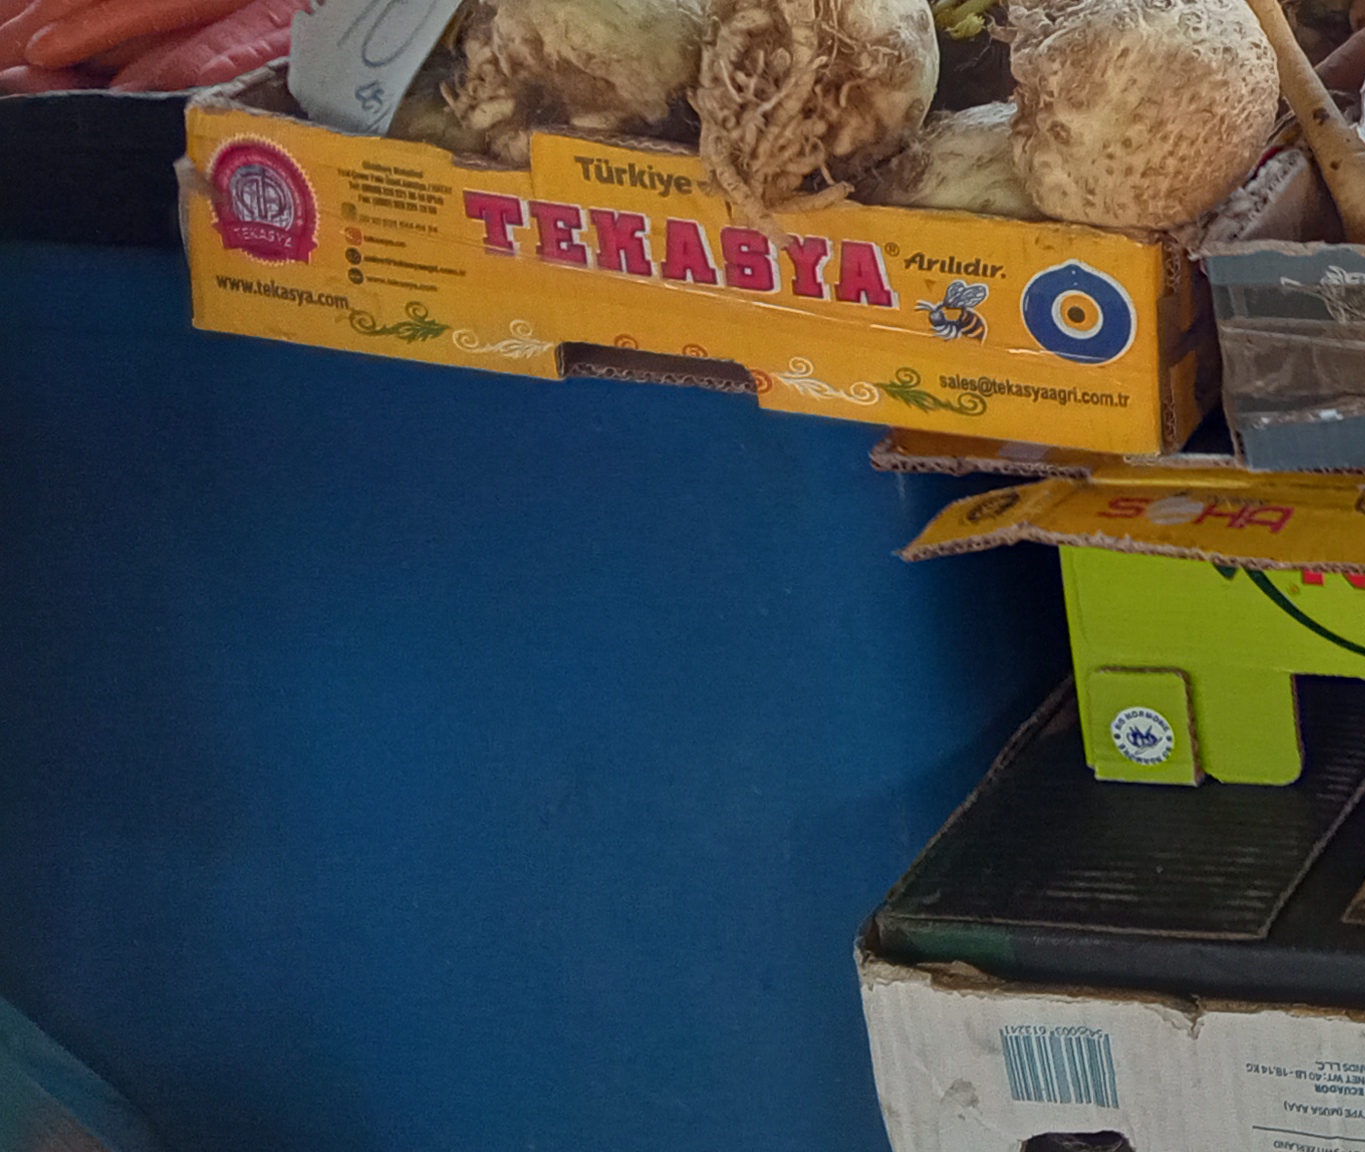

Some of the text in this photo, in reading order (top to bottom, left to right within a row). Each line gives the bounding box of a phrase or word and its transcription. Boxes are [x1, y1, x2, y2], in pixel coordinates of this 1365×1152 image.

[574, 155, 693, 198] Türkiye
[463, 190, 899, 309] TEKASYA
[216, 275, 350, 309] www.tekasya.com
[939, 373, 1130, 408] sales@tekasyaagri.com.tr
[1314, 1084, 1364, 1096] ECUADOR
